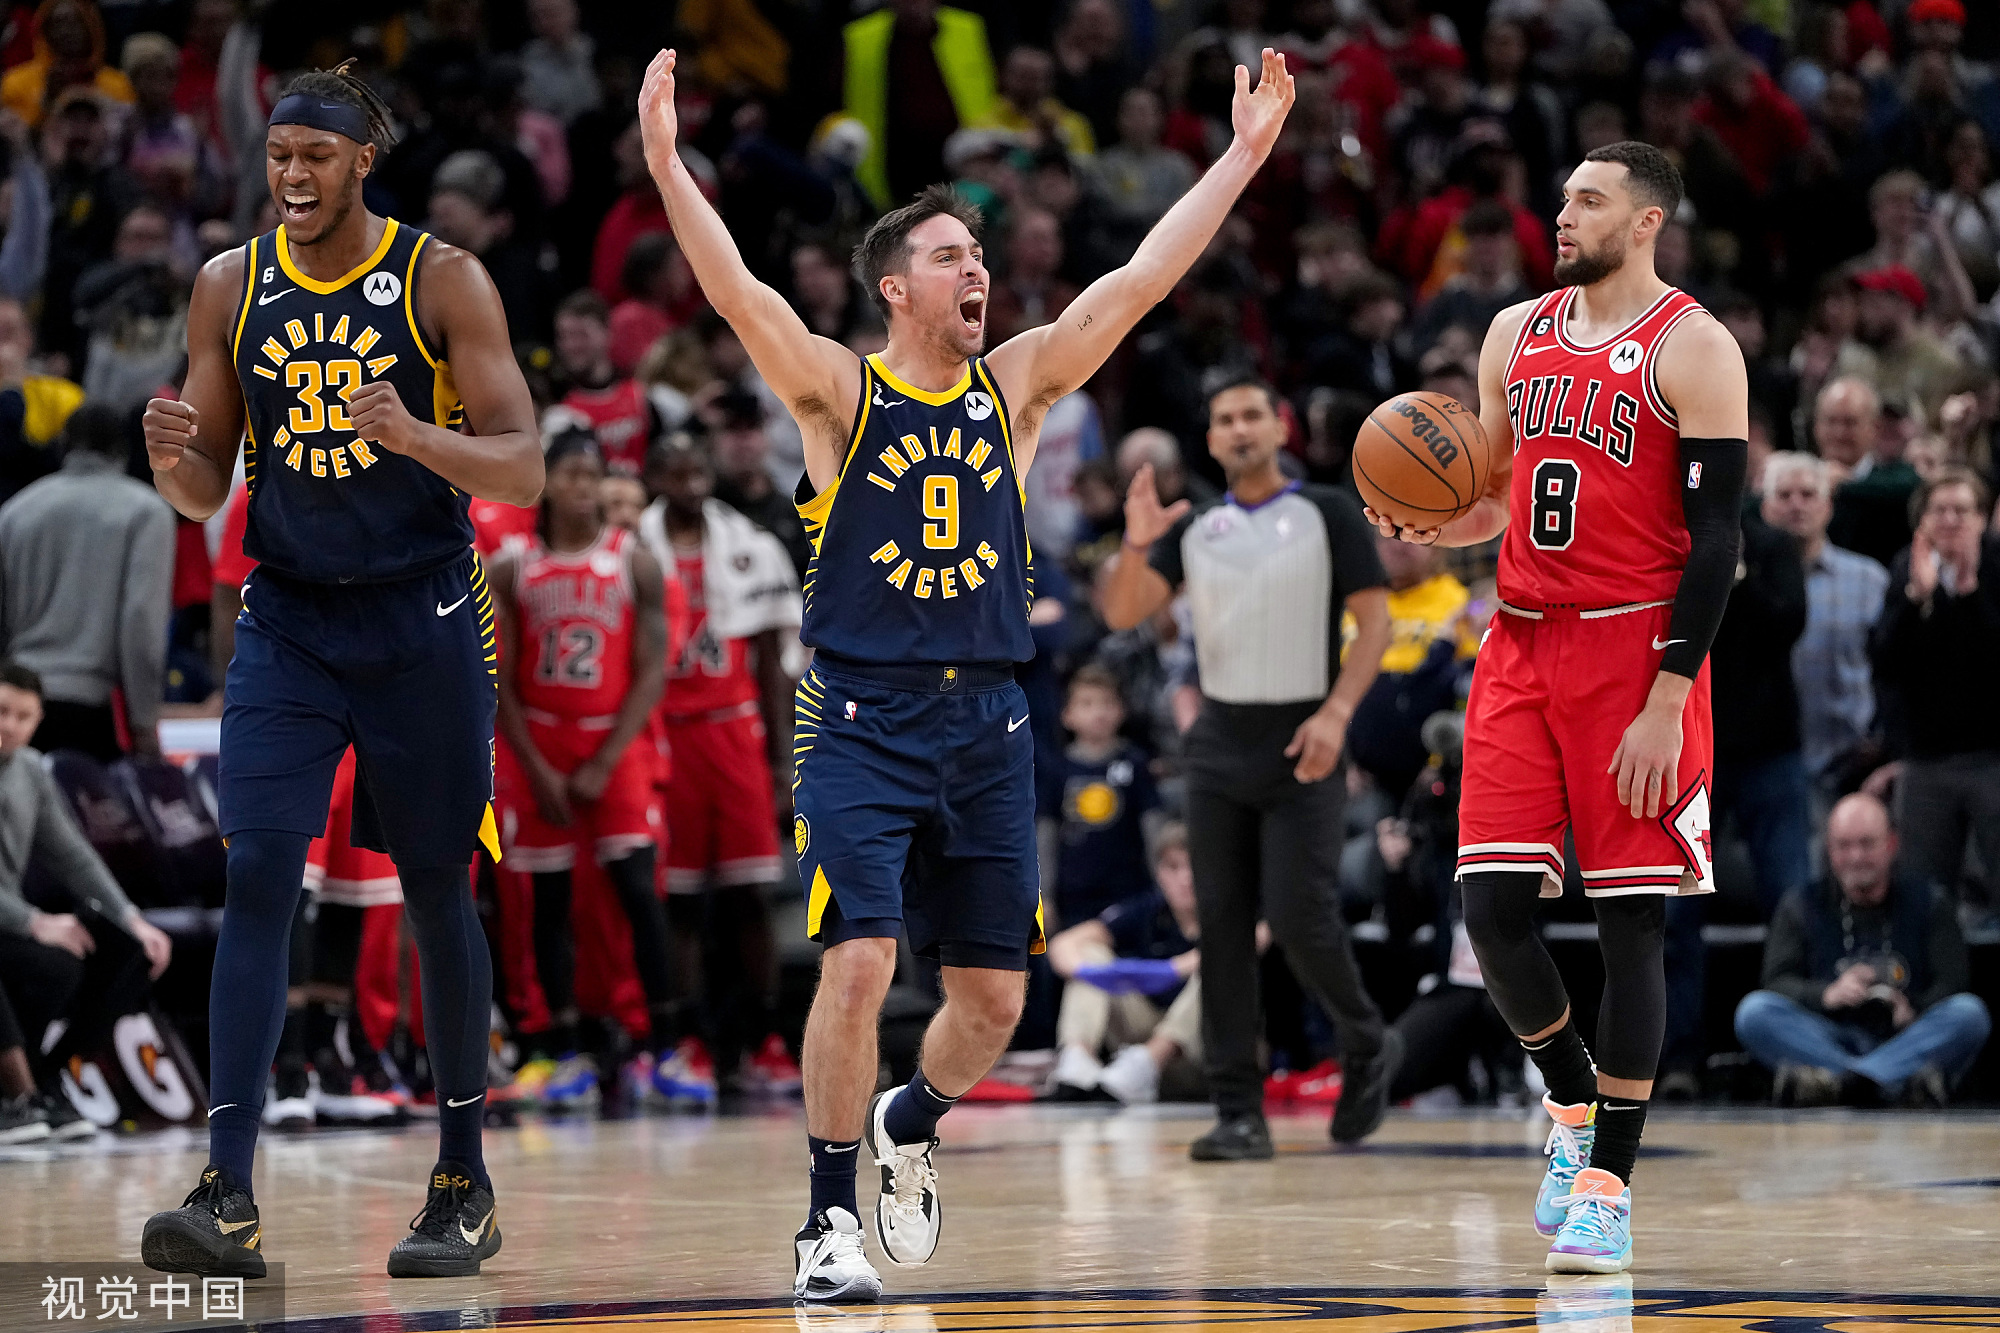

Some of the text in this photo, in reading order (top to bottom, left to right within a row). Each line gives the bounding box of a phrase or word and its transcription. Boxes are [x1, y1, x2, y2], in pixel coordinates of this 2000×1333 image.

[262, 266, 275, 284] 6
[253, 312, 399, 381] INDIANA
[1535, 317, 1552, 335] 6
[285, 359, 362, 434] 33
[273, 424, 384, 479] PACER
[866, 426, 1003, 493] INDIANA
[1388, 400, 1459, 470] Wilson
[922, 474, 960, 550] 9
[1529, 457, 1582, 551] 8
[869, 539, 999, 600] PACERS
[534, 623, 604, 689] 12
